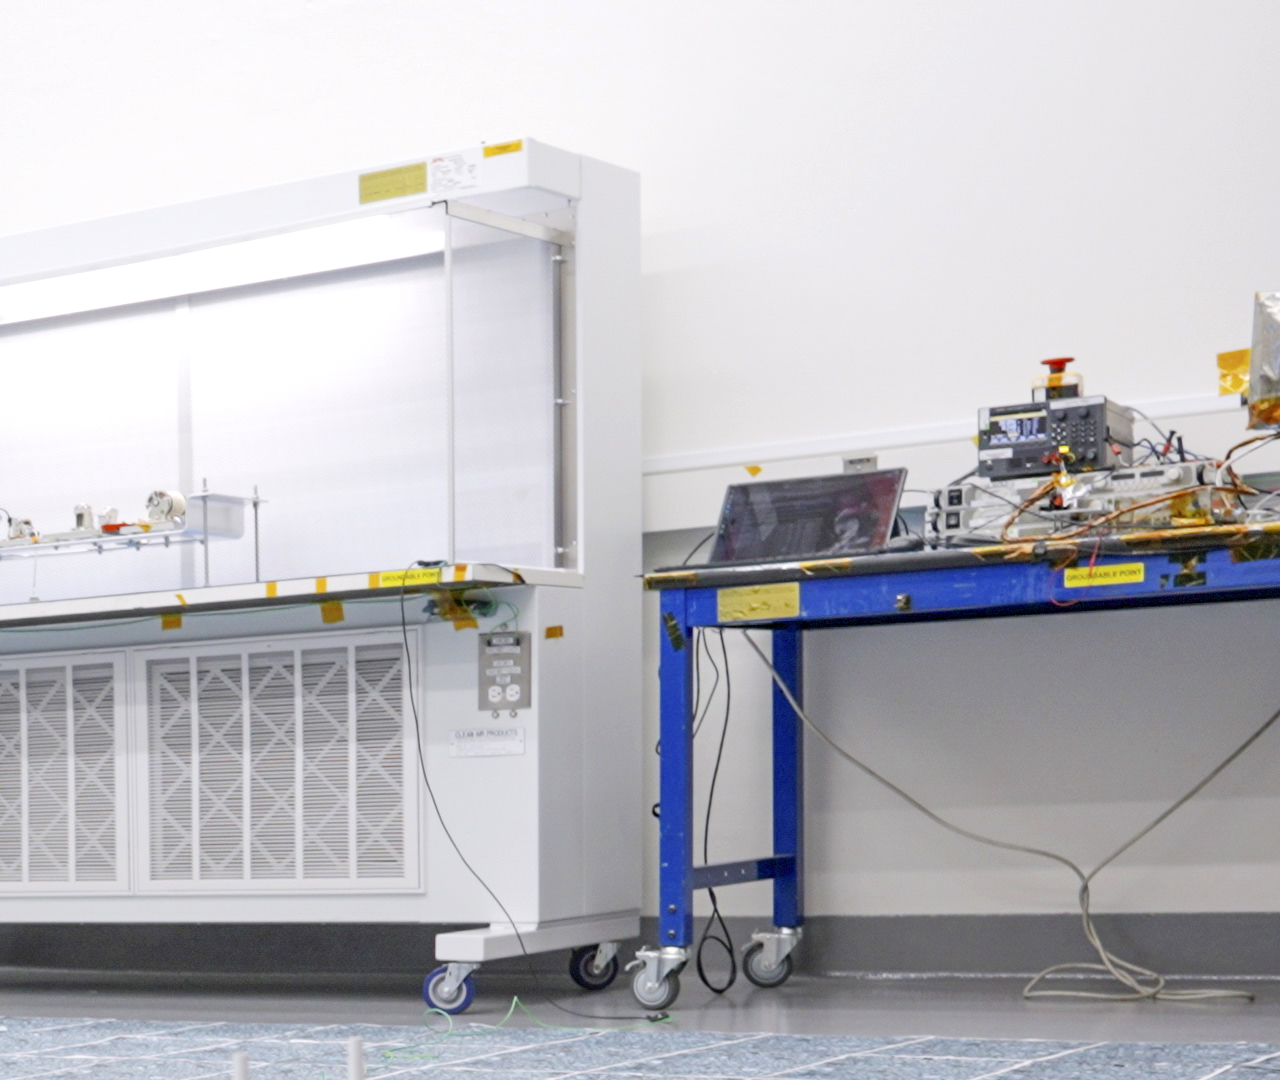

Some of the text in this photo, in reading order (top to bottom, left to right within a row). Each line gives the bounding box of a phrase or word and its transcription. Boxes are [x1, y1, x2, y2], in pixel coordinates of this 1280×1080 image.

[455, 729, 518, 739] CLEAN AIR PRODUCTS
